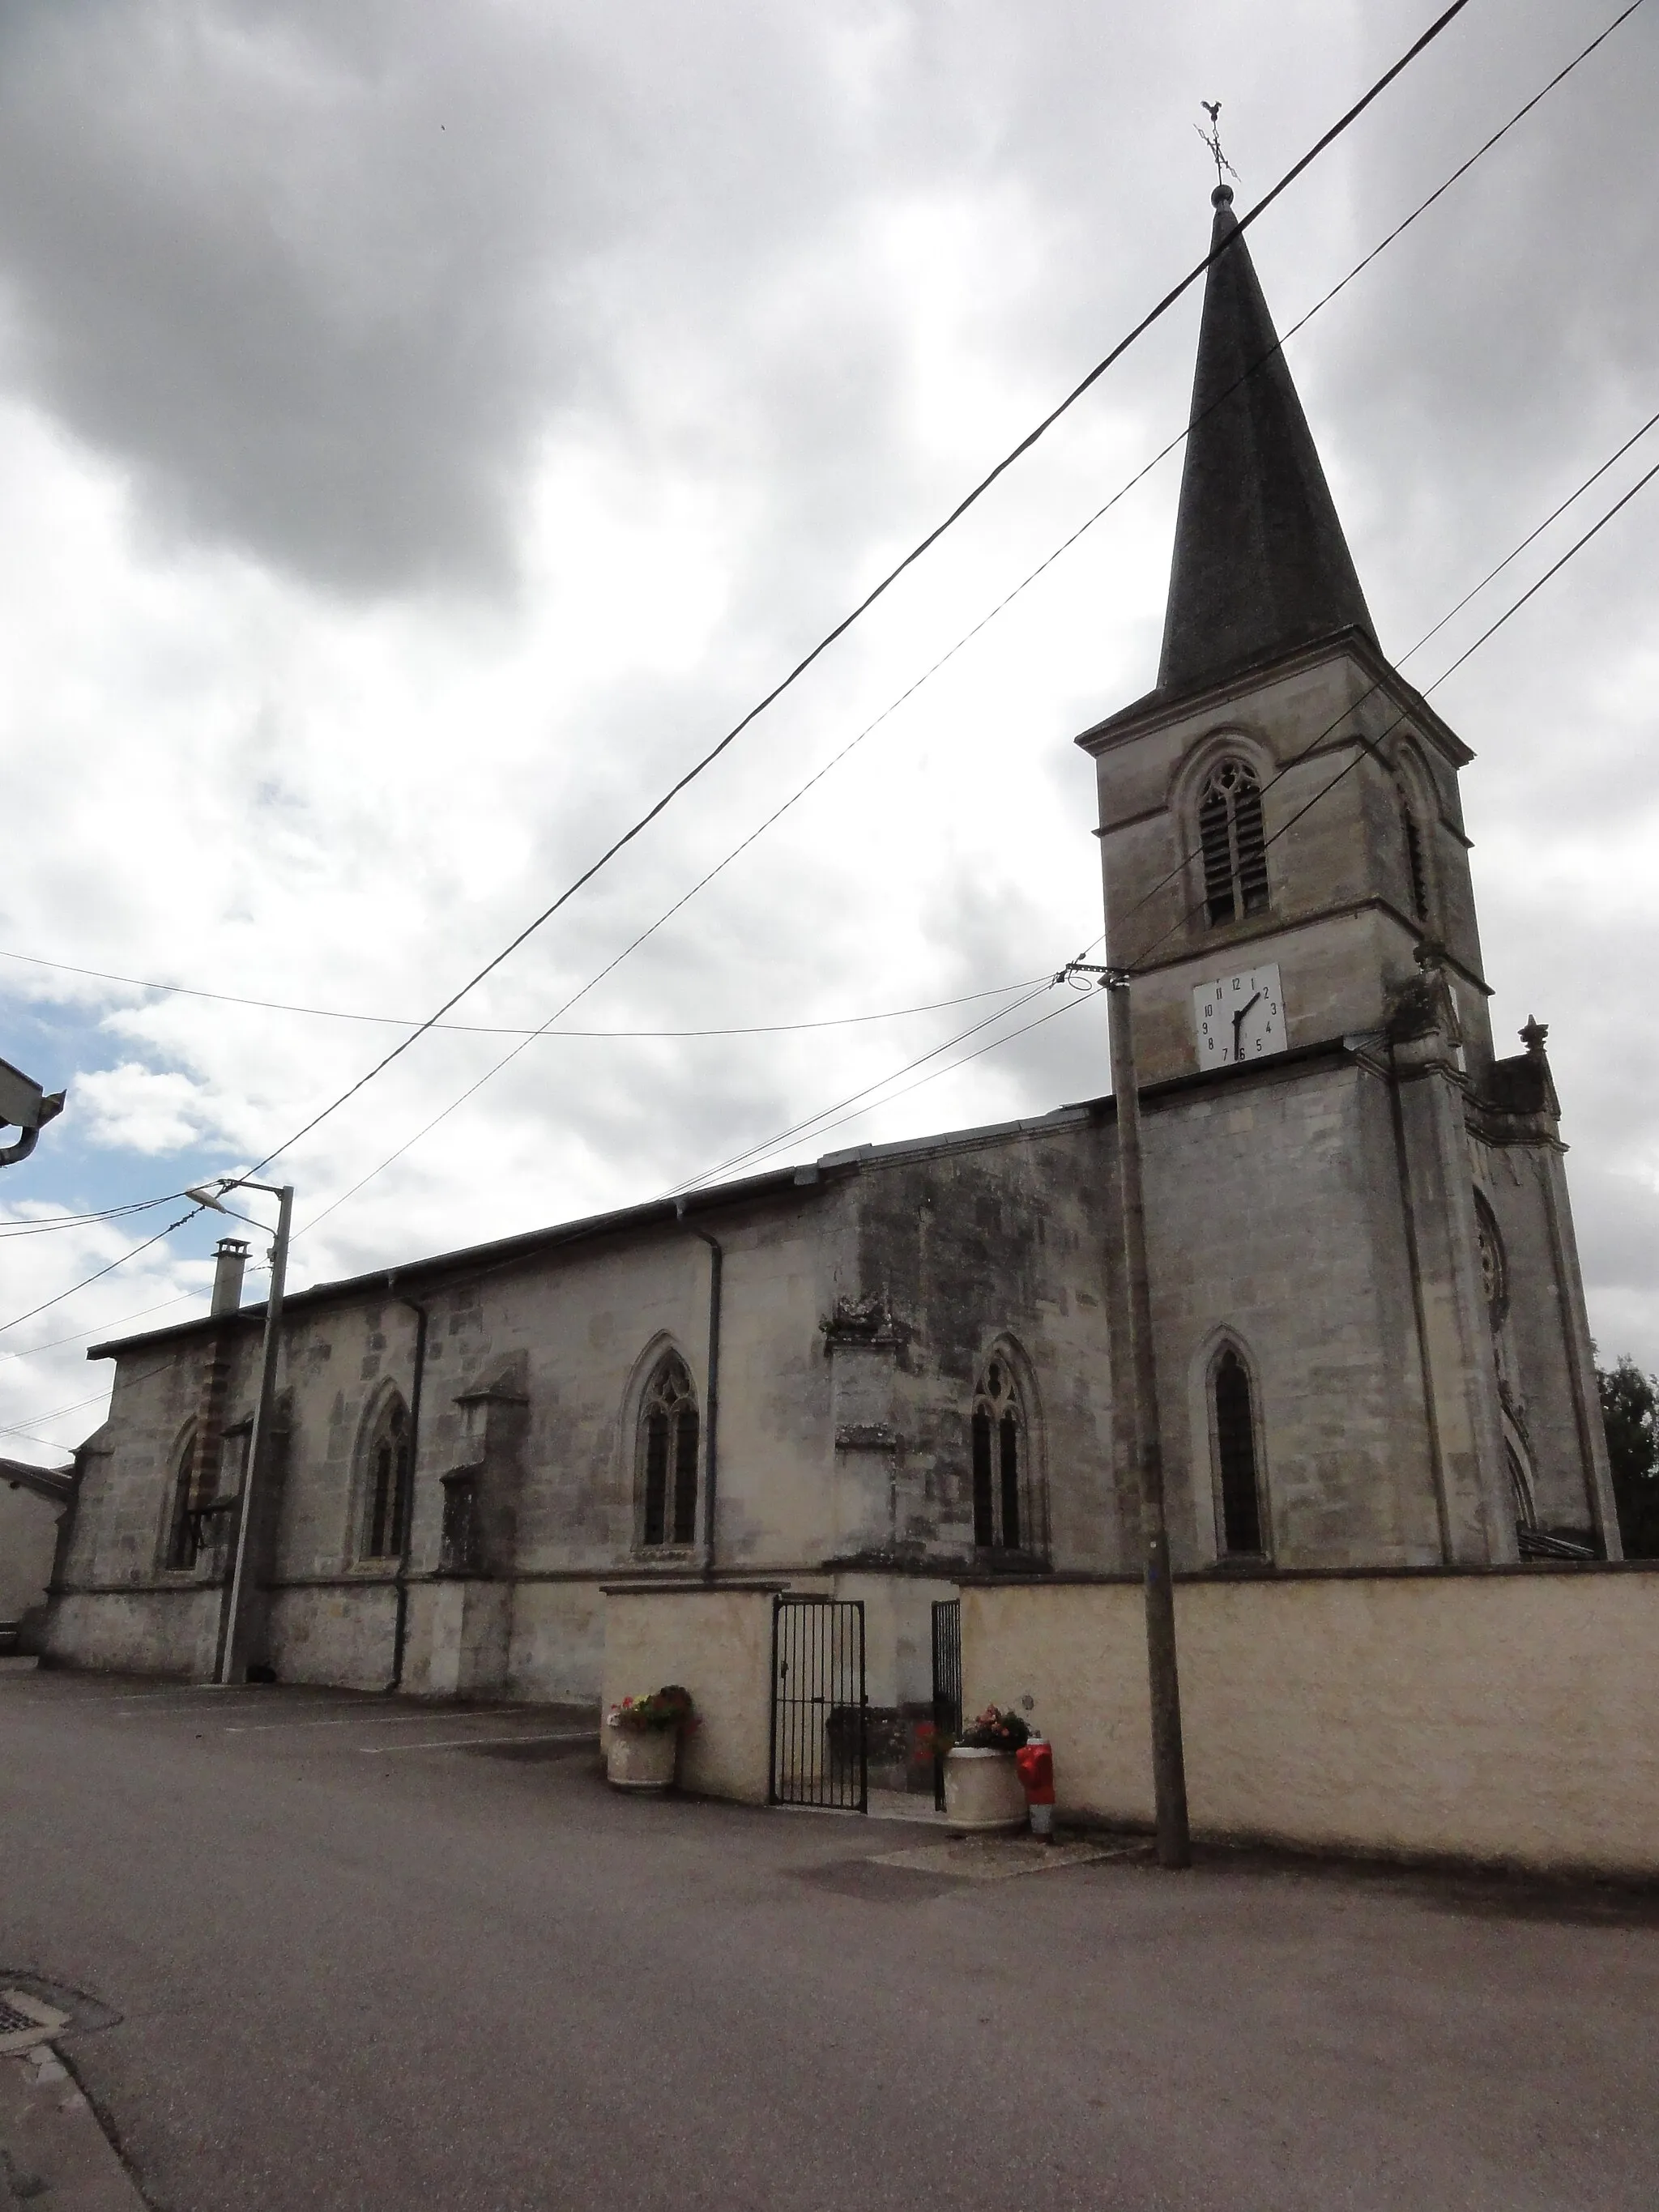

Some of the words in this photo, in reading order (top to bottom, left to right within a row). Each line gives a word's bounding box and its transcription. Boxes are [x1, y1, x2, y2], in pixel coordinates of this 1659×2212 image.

[1231, 978, 1241, 991] 12
[1216, 987, 1222, 1000] 11
[1263, 987, 1269, 999] 2
[1205, 1004, 1213, 1017] 10
[1270, 1003, 1277, 1015] 3
[1202, 1022, 1208, 1035] 9
[1265, 1021, 1272, 1034] 4
[1208, 1038, 1214, 1050] 8
[1256, 1038, 1262, 1051] 5
[1222, 1048, 1228, 1061] 7
[1239, 1048, 1245, 1060] 6
